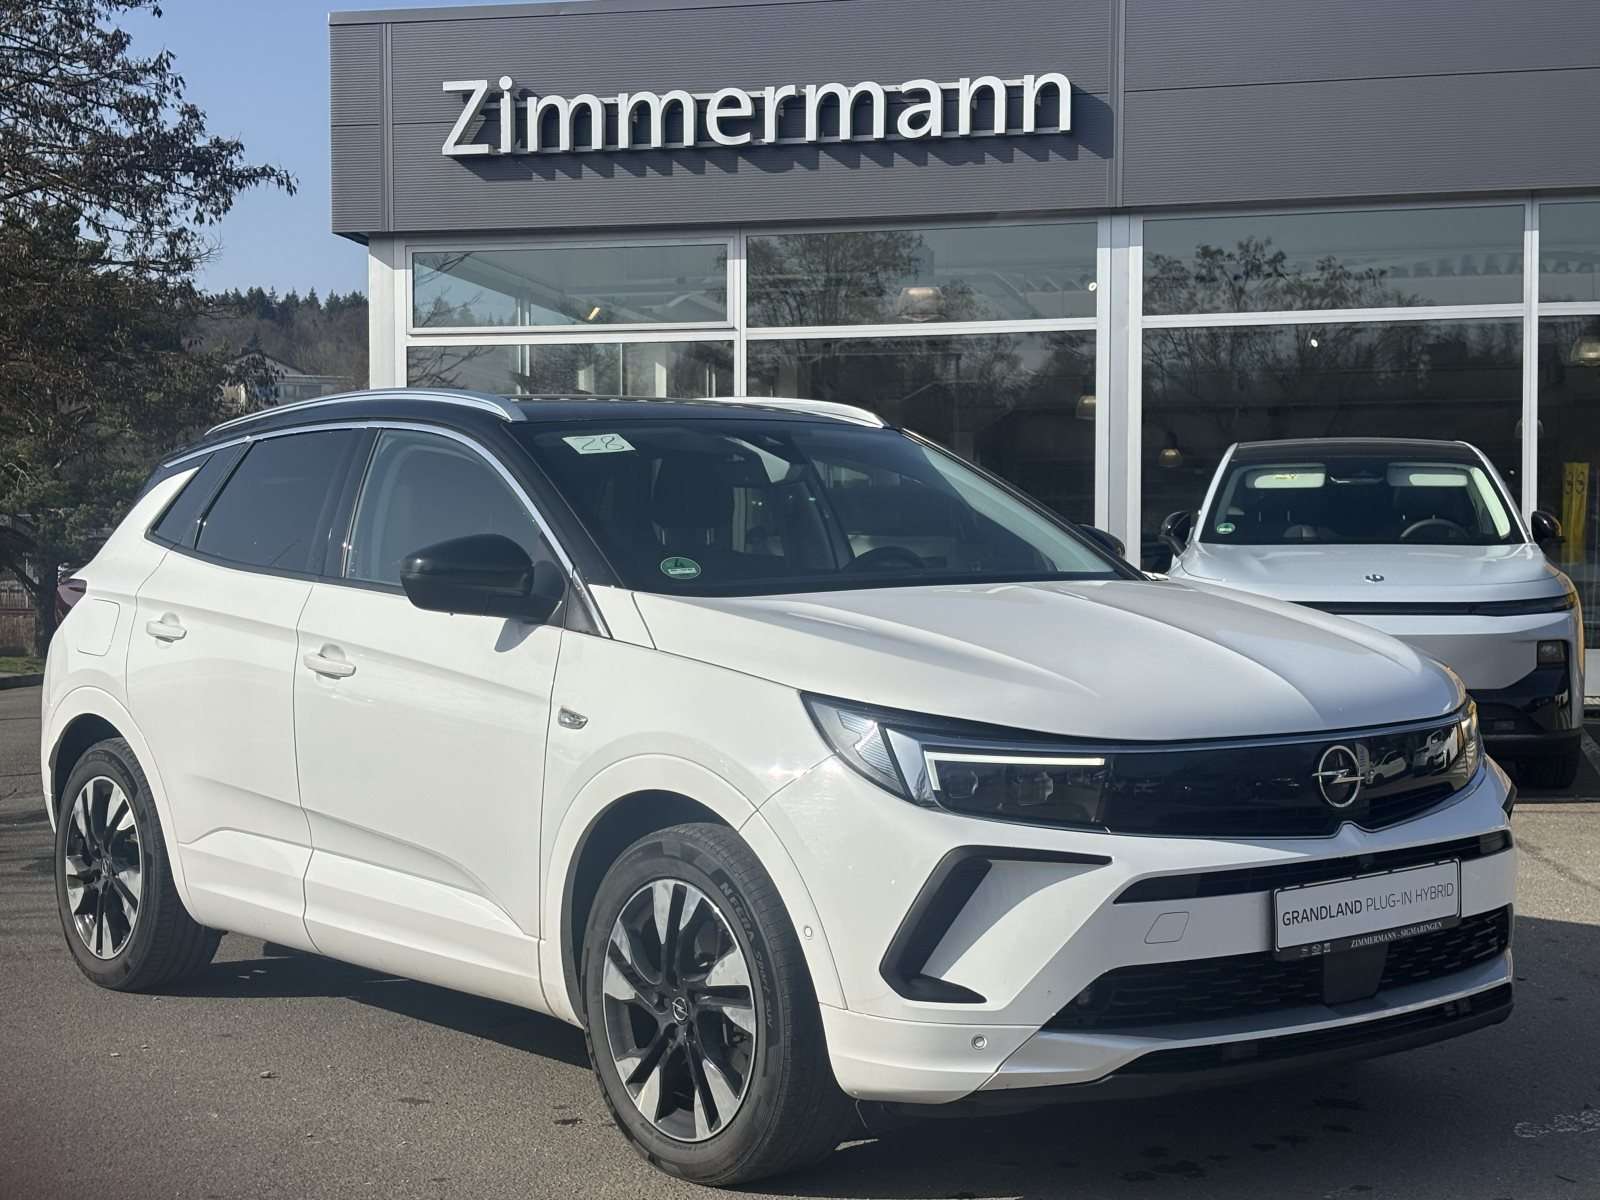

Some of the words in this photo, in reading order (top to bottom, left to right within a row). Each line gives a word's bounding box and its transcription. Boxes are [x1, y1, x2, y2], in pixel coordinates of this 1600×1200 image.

[441, 71, 1073, 156] Zimmermann
[574, 435, 625, 451] 28
[1282, 900, 1362, 926] GRANDLAND
[1365, 892, 1411, 911] PLUG-IN
[1415, 883, 1454, 902] HYBRID
[1350, 931, 1397, 949] ZIMMERMANN
[1400, 921, 1443, 938] SIGMARINGEN
